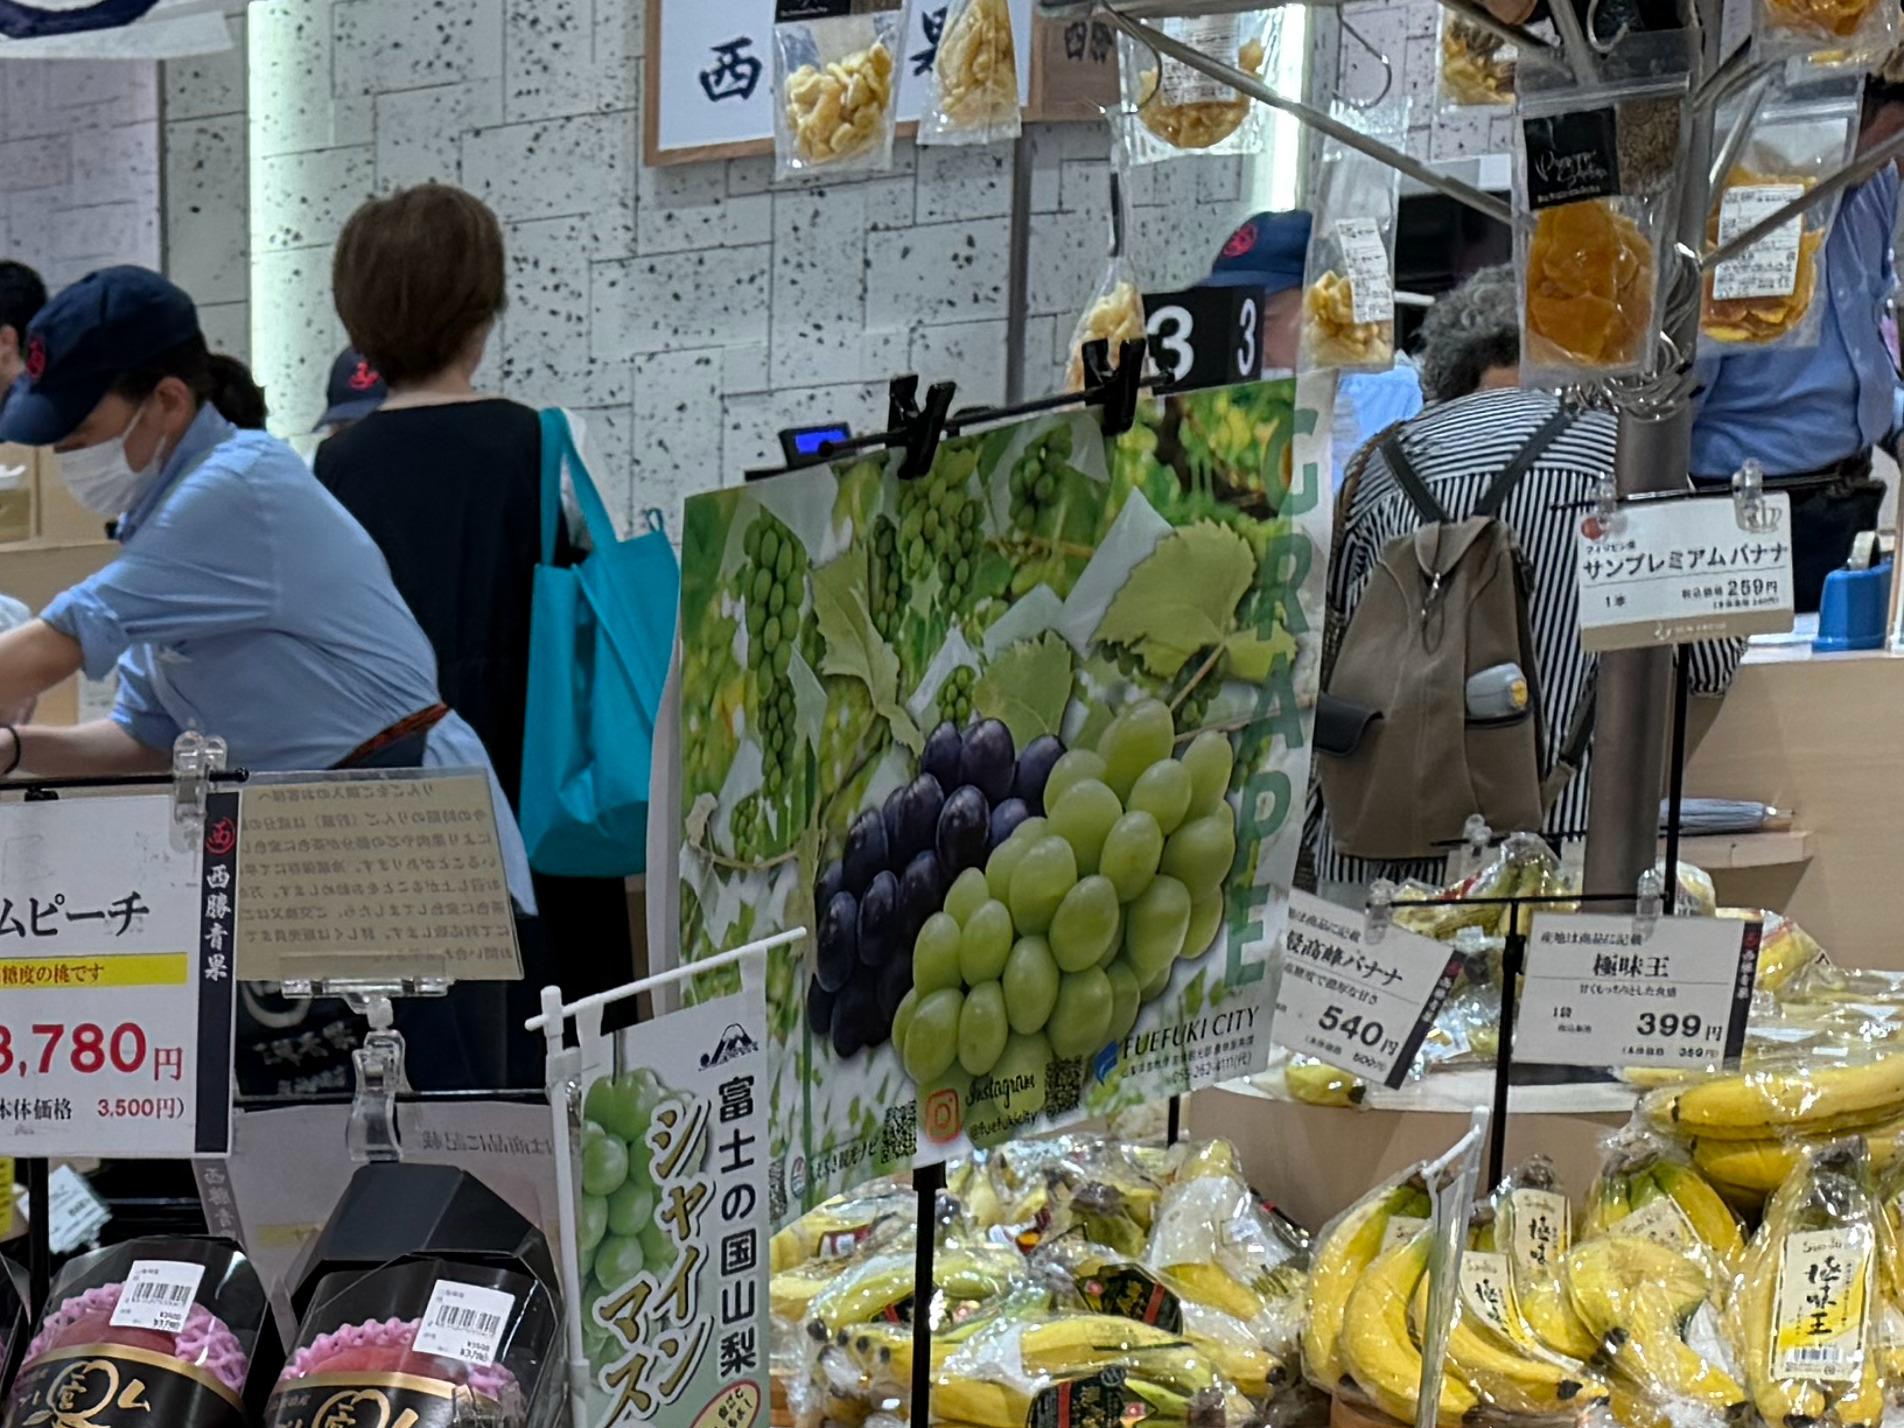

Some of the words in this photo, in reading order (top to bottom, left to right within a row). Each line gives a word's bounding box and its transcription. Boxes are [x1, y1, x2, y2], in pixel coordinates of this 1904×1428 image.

[698, 36, 763, 103] 西
[1147, 305, 1195, 380] 3
[1236, 298, 1257, 377] 3
[1584, 542, 1788, 580] サンプレミアムバナナ
[1728, 579, 1777, 597] 259円
[1225, 409, 1318, 989] GRAPE
[204, 866, 230, 981] 西勝青果
[1594, 953, 1670, 979] 極味王
[1121, 1019, 1208, 1061] FUEFUKI
[1209, 1004, 1261, 1038] CITY
[1318, 1005, 1400, 1059] 540円
[1636, 1013, 1722, 1042] 399円
[97, 1095, 186, 1121] 3,500円)
[964, 1072, 1037, 1109] Instagram
[647, 1099, 718, 1395] シャイン
[717, 1075, 760, 1379] 富士の国山梨
[1802, 1255, 1843, 1337] 極味王
